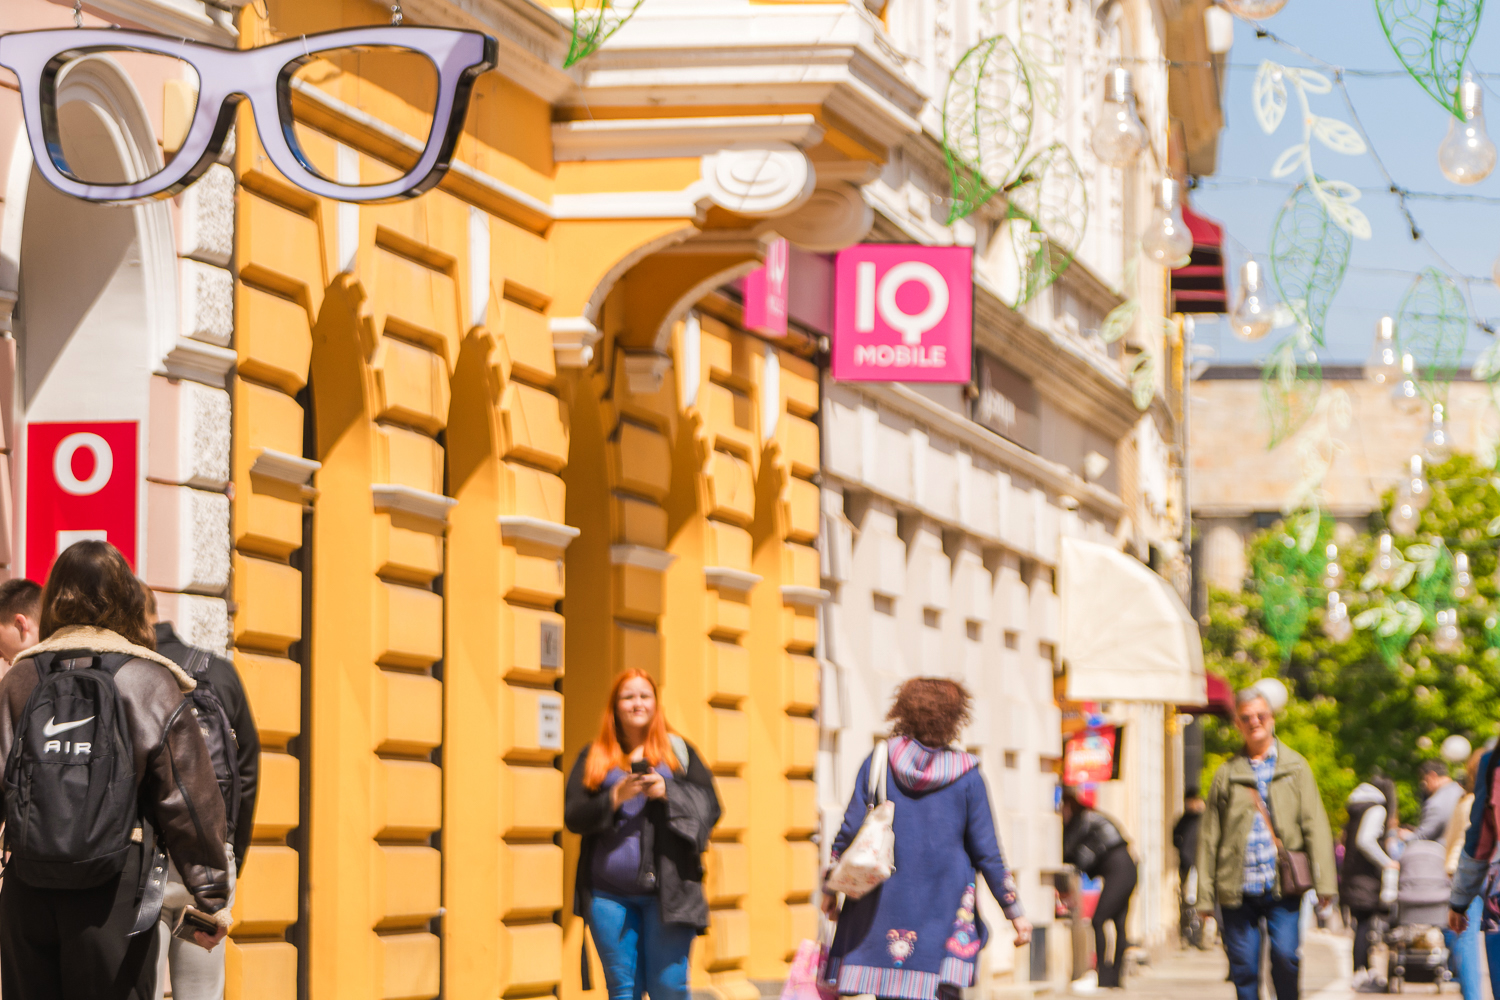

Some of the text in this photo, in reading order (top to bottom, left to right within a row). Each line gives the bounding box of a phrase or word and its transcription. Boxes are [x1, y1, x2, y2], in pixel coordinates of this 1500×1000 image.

[856, 261, 949, 344] IQ
[855, 345, 947, 368] MOBILE
[43, 739, 92, 755] AIR
